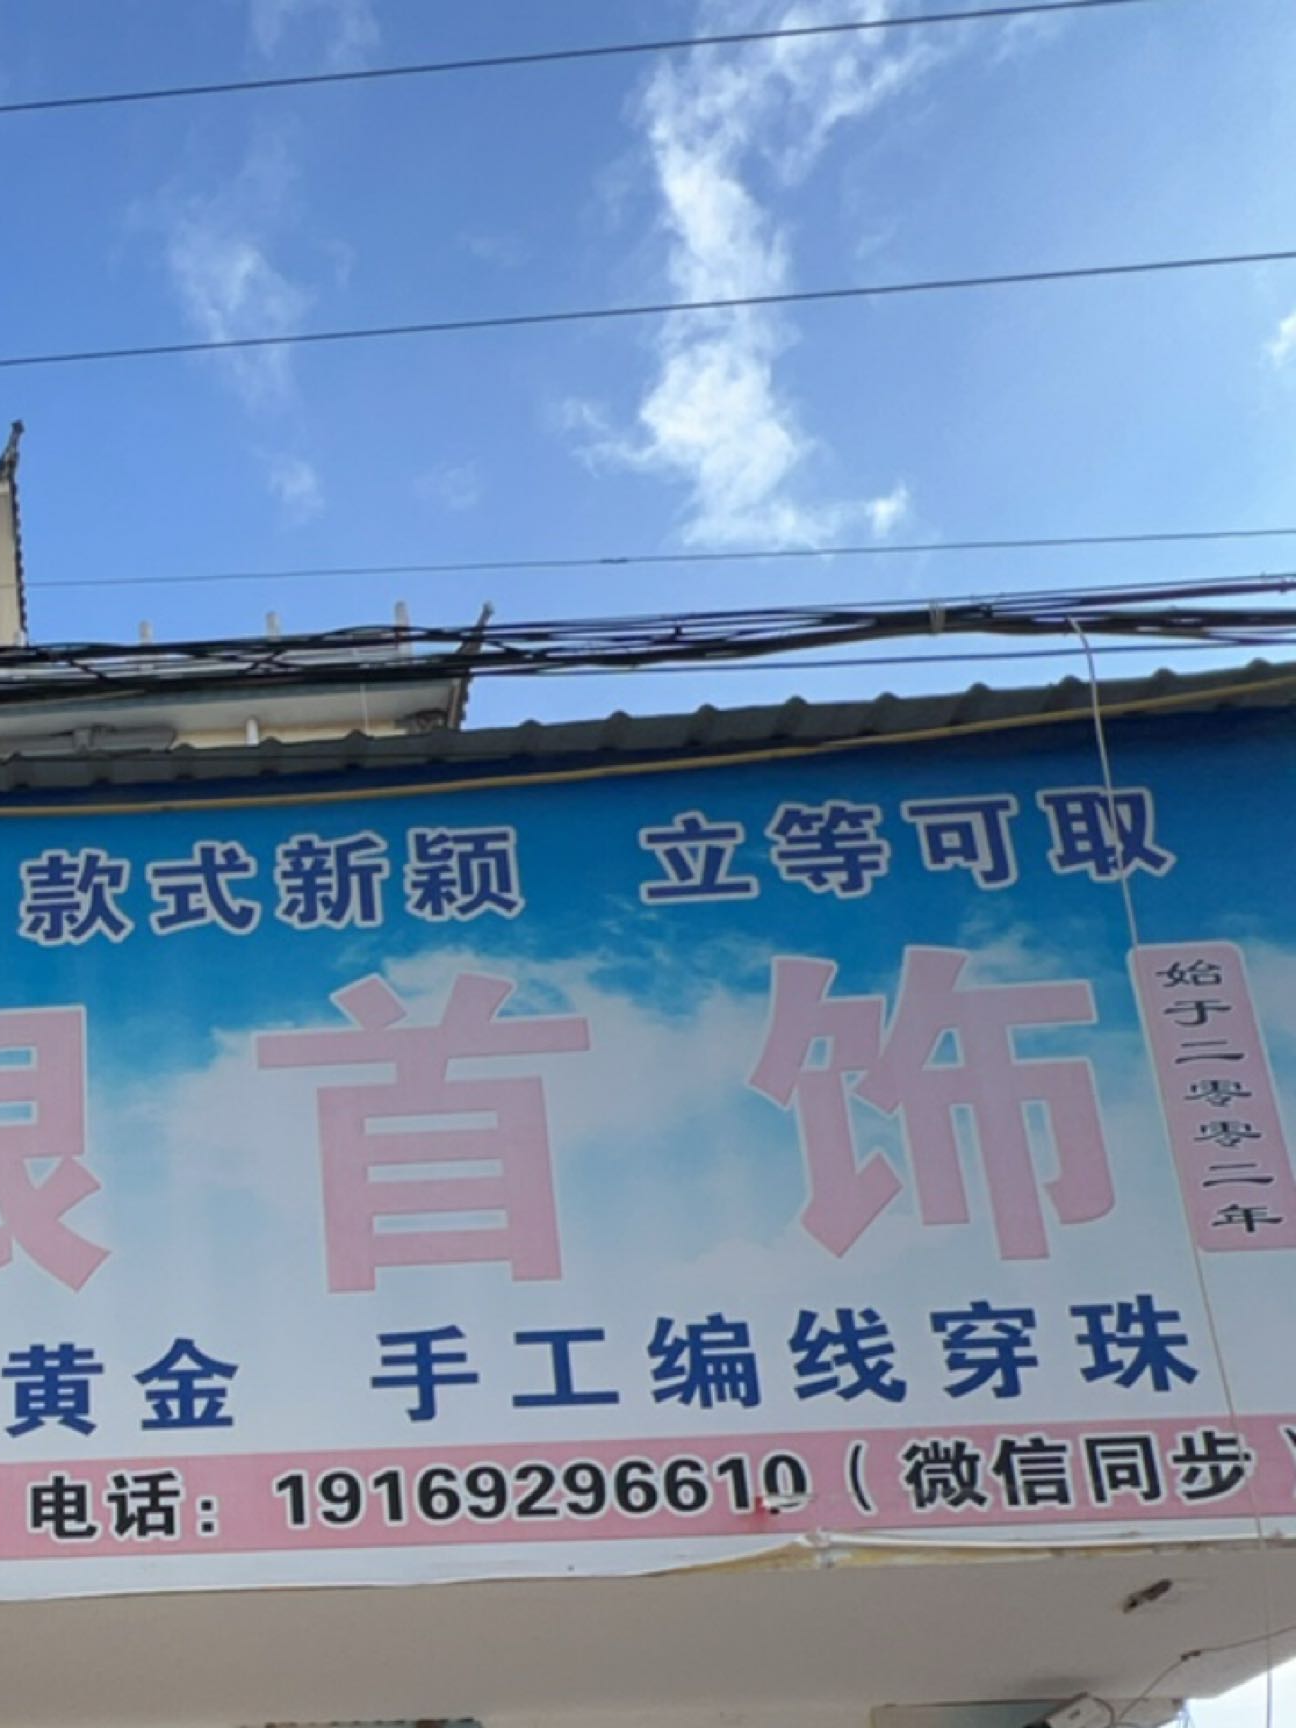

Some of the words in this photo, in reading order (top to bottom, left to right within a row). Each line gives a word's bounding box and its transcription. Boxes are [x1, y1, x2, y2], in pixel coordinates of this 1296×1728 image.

[19, 825, 524, 946] 款式新颖
[639, 786, 1179, 905] 立等可取
[1155, 958, 1284, 1234] 始于二零零二年
[371, 1294, 1200, 1424] 手工编线穿珠
